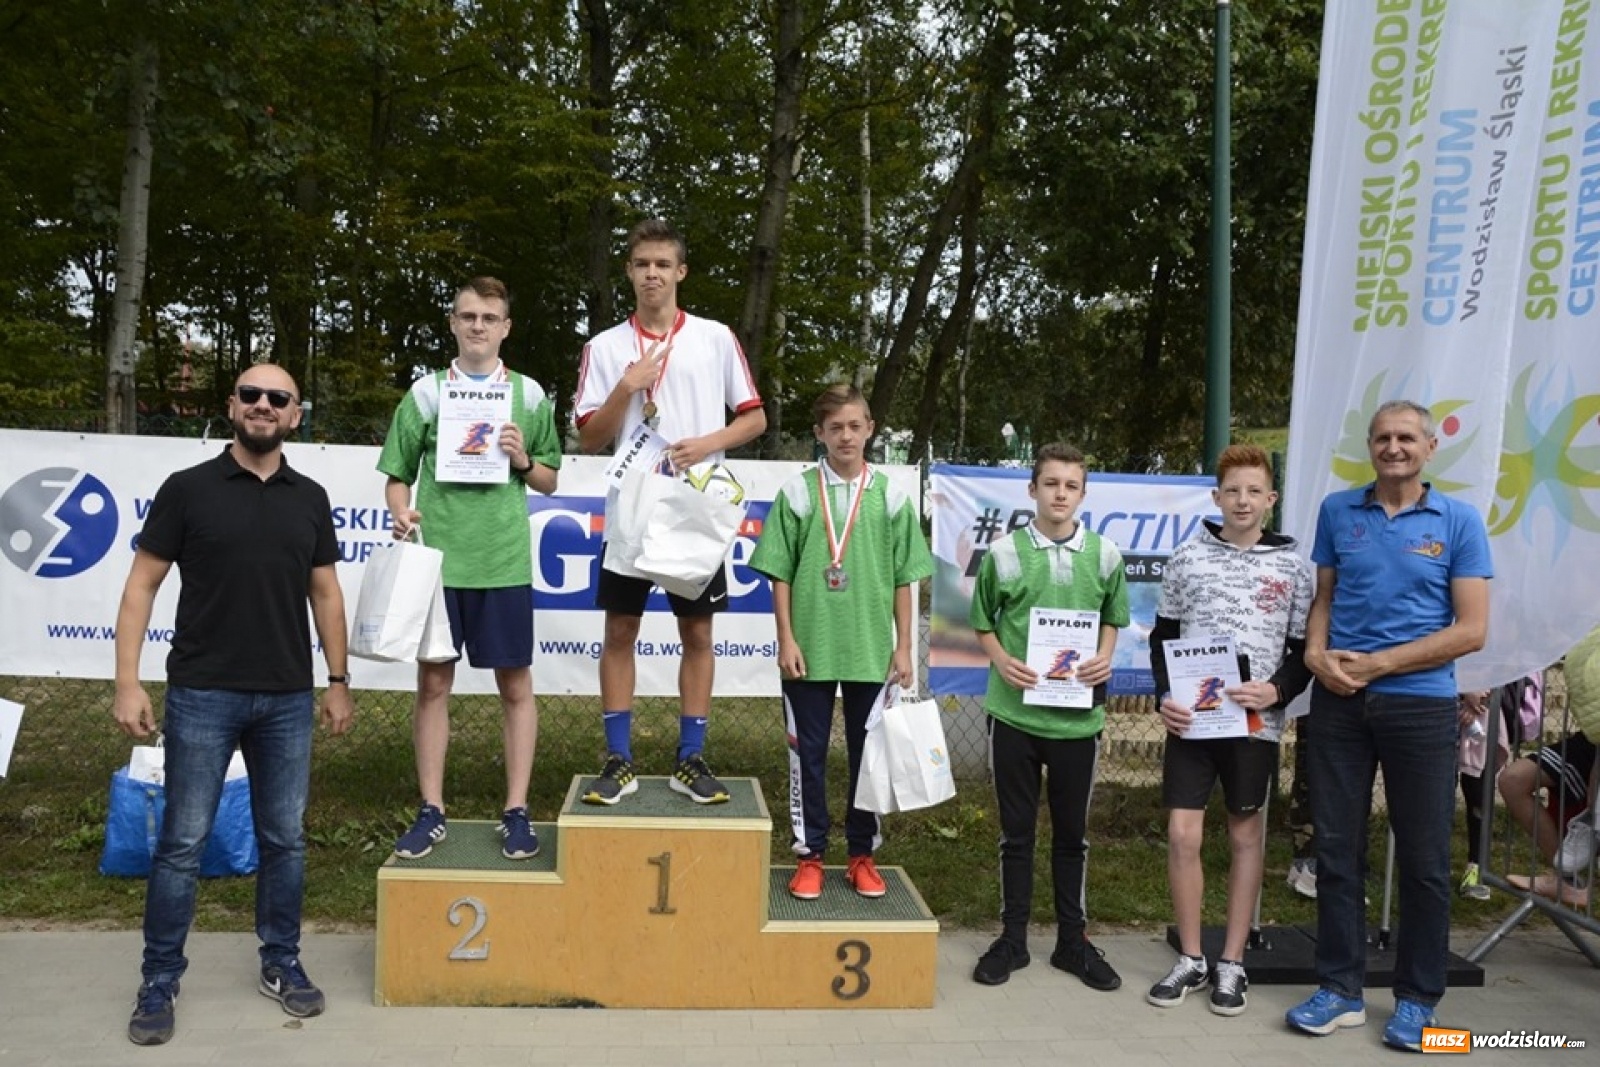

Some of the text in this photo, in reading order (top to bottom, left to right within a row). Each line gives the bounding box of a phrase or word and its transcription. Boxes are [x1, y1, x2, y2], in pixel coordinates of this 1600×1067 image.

[1460, 44, 1528, 322] Wodzisław Śląski
[1524, 0, 1592, 321] SPORTU I REKR
[1422, 108, 1478, 326] CENTRUM
[1353, 175, 1396, 333] MIEJSKI
[449, 391, 506, 401] DYPLOM
[614, 432, 651, 479] DYPLOM
[1038, 618, 1093, 630] DYPLOM
[1172, 646, 1229, 658] DYPLOM
[647, 851, 678, 915] 1
[447, 895, 491, 961] 2
[830, 939, 873, 1000] 3
